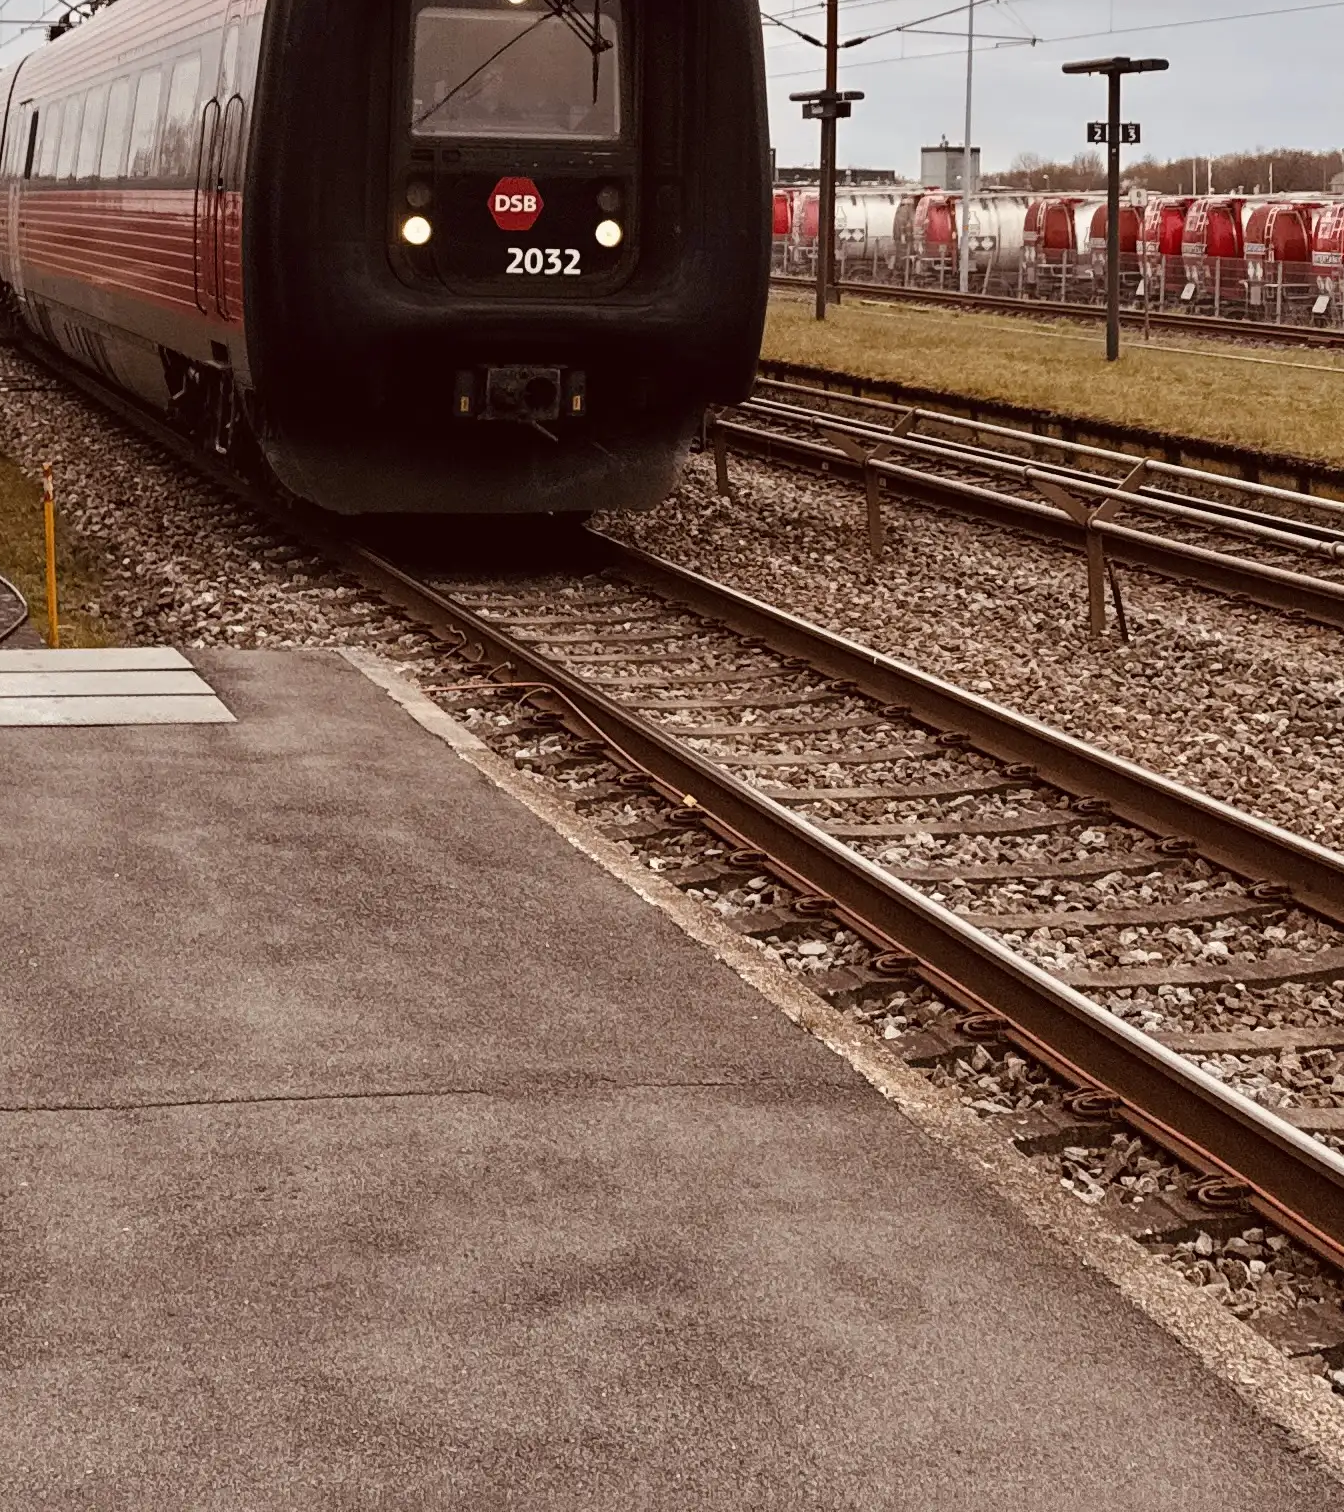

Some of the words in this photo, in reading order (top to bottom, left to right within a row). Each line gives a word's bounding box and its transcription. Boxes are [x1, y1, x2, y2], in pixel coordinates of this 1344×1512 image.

[1093, 128, 1102, 141] 2
[1127, 128, 1136, 141] 3
[495, 194, 537, 212] DSB
[505, 247, 581, 275] 2032
